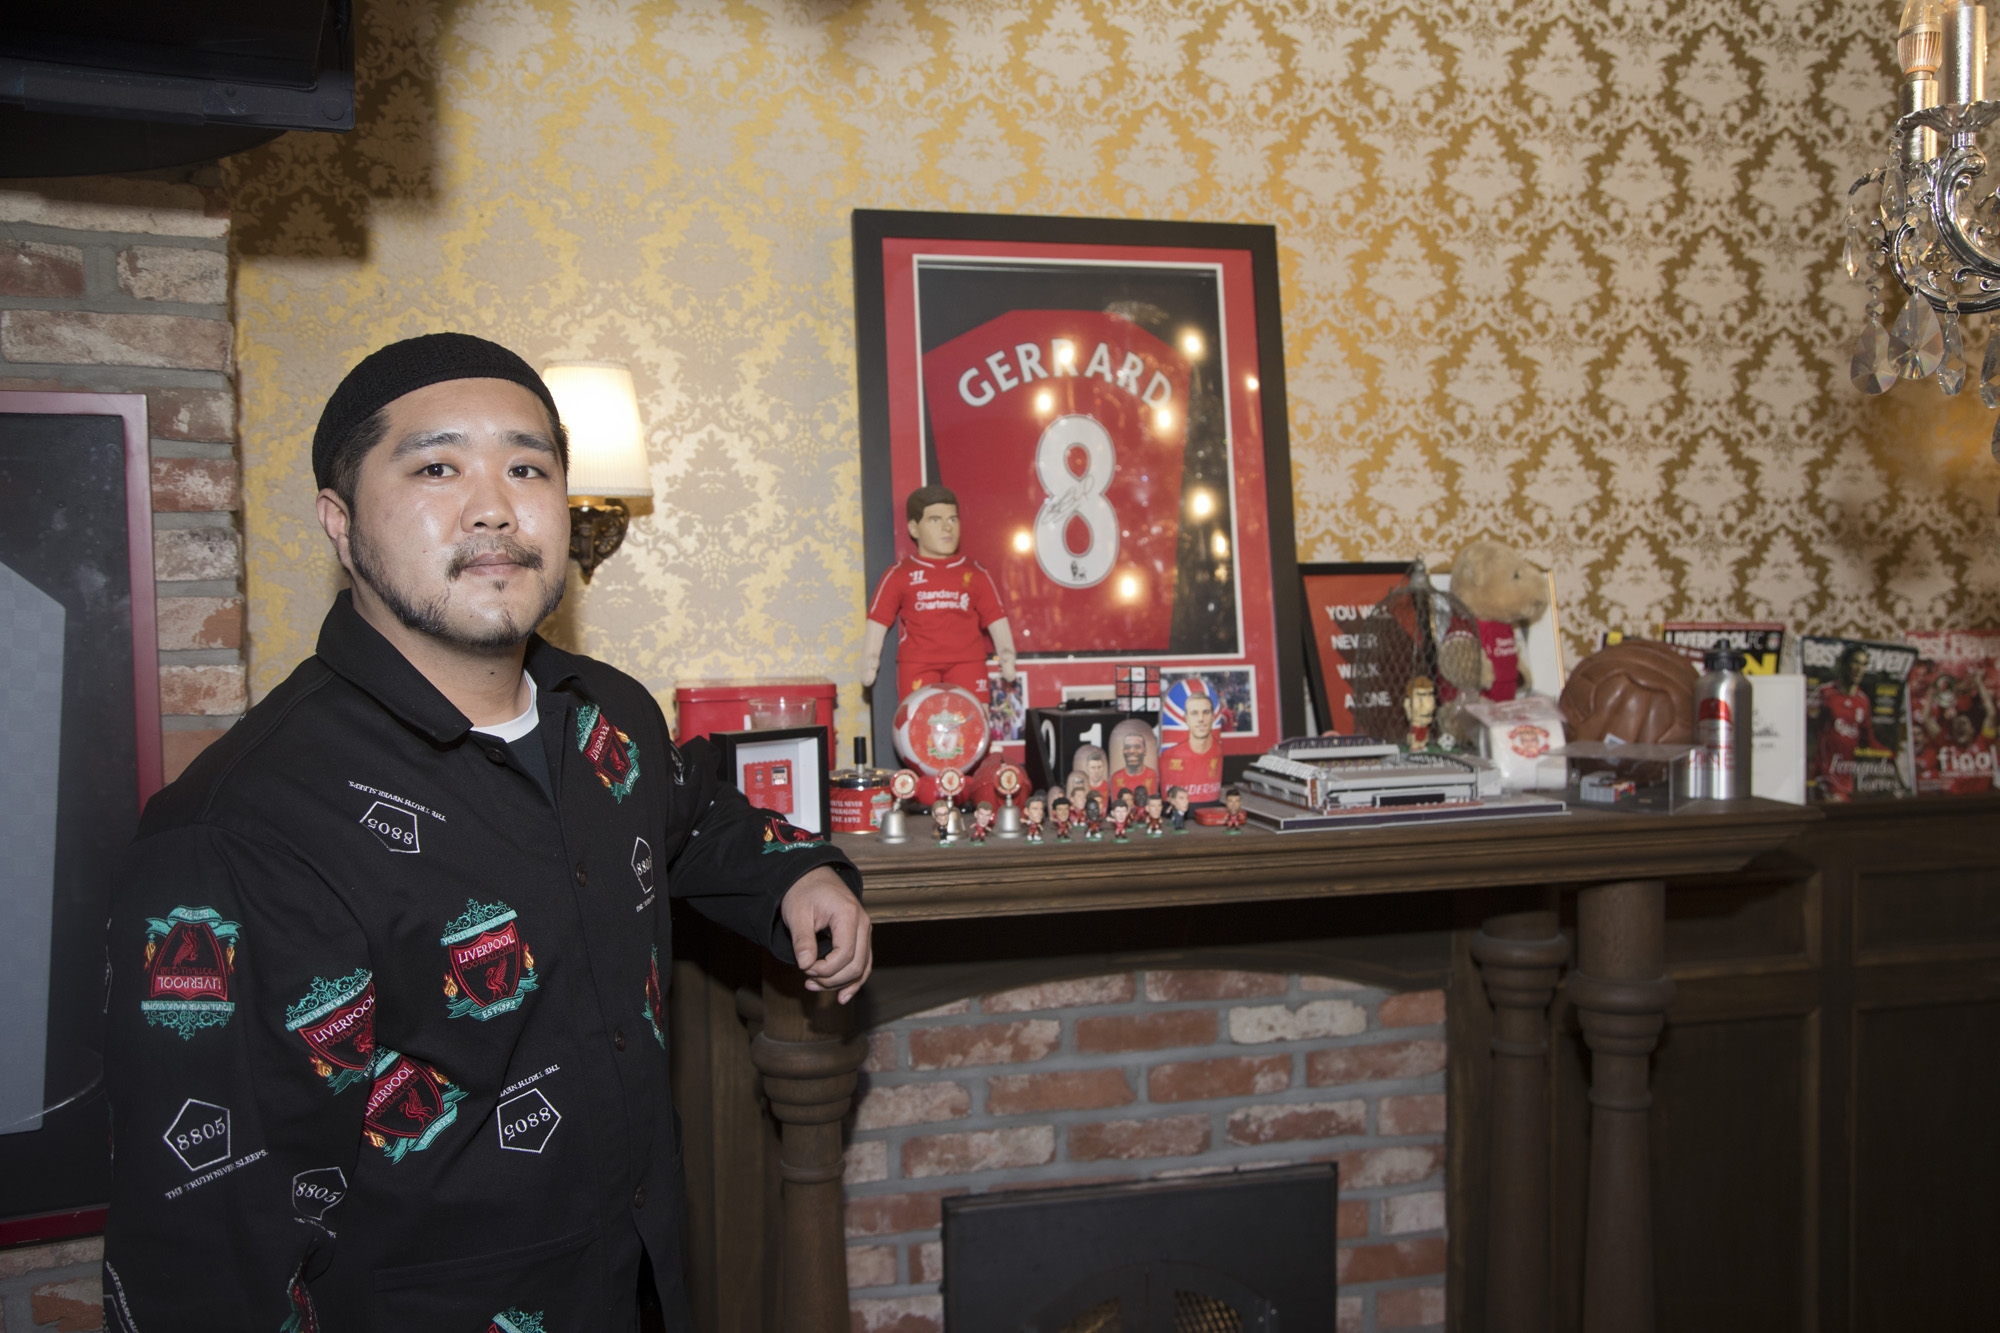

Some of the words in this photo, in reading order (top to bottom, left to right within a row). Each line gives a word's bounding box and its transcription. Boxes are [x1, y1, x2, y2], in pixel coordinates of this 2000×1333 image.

[958, 338, 1172, 408] GERRARD
[1034, 413, 1120, 589] 8
[1325, 604, 1357, 621] YOU
[1331, 633, 1378, 650] NEVER
[367, 818, 413, 845] 8805
[458, 934, 516, 964] LIVERPOOL
[157, 976, 222, 990] LIVERPOOL
[334, 989, 358, 1006] WALK
[313, 995, 376, 1043] LIVERPOOL
[544, 1064, 560, 1076] THE
[365, 1066, 415, 1117] LIVERPOOL
[500, 1084, 518, 1098] NEV
[177, 1116, 226, 1151] 8805
[504, 1107, 551, 1141] 8805
[296, 1182, 341, 1203] 8805
